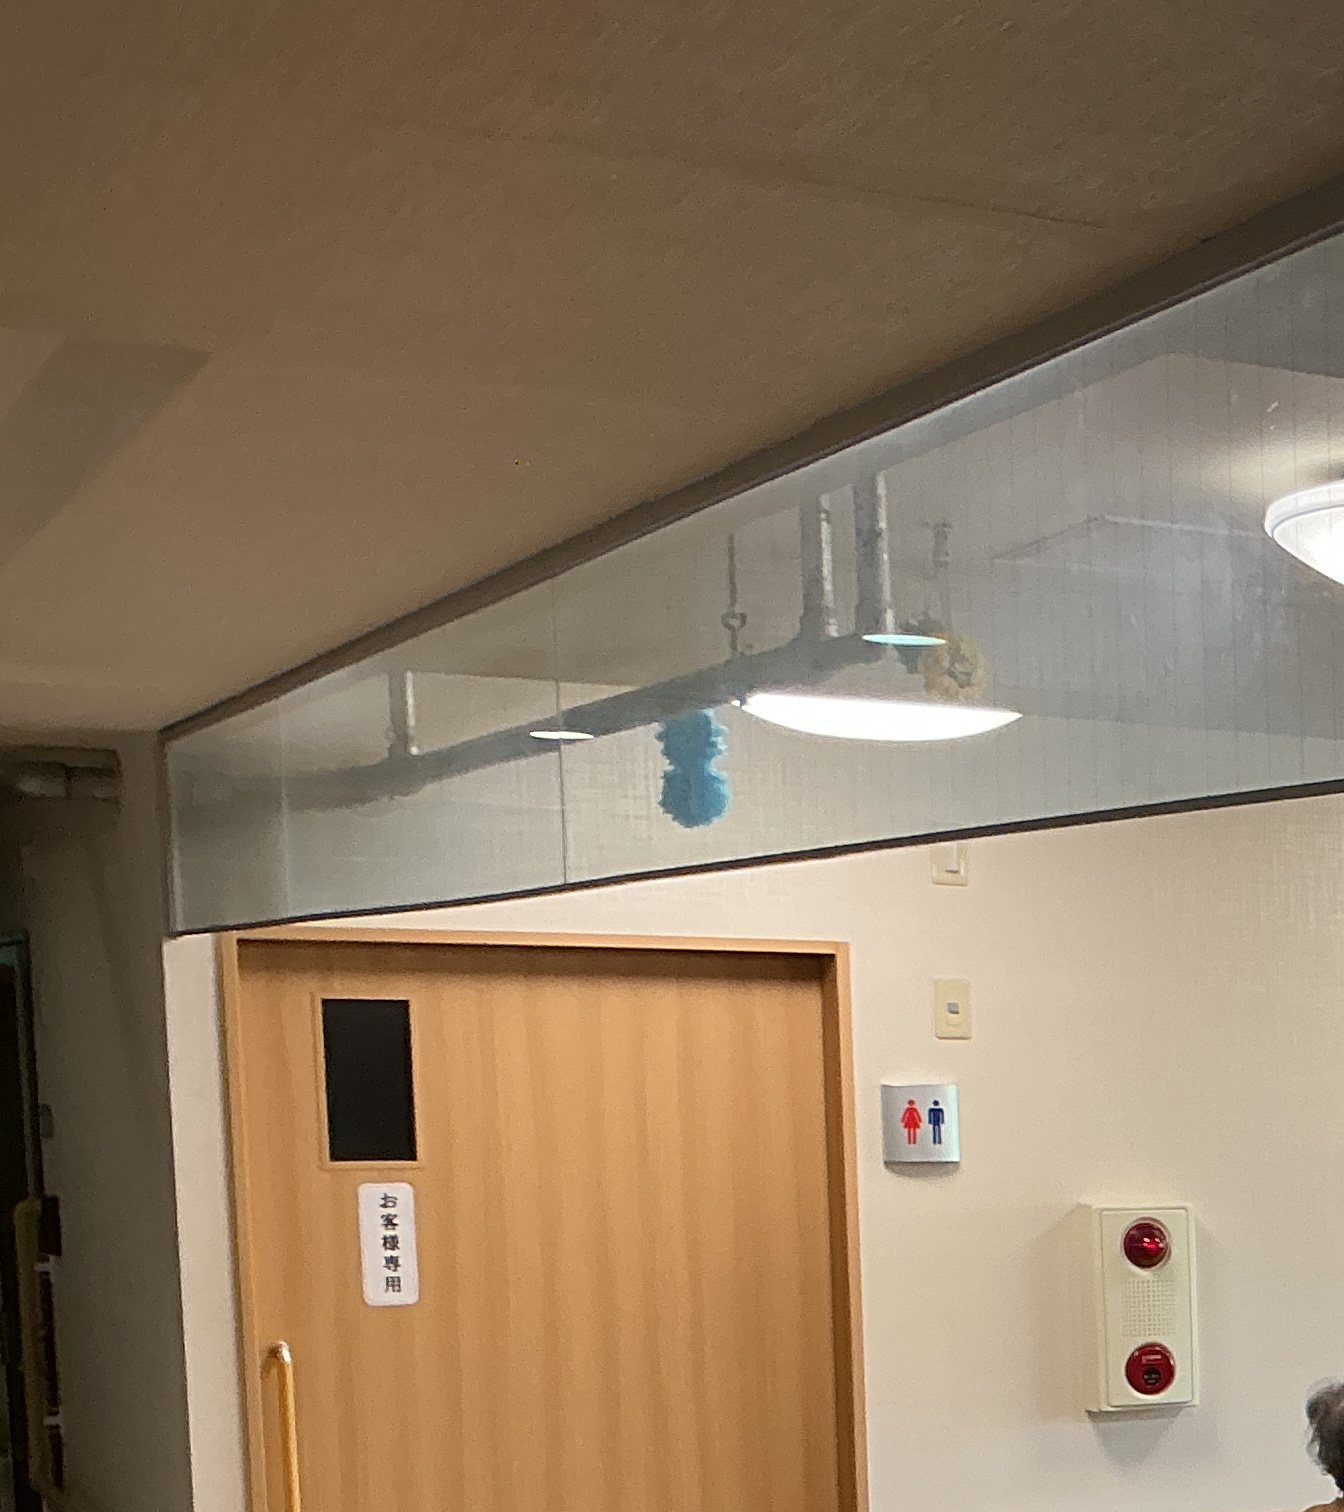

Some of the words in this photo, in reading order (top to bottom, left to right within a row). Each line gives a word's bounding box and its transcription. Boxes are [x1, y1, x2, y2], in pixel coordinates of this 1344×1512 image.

[379, 1192, 401, 1293] お客様専用
